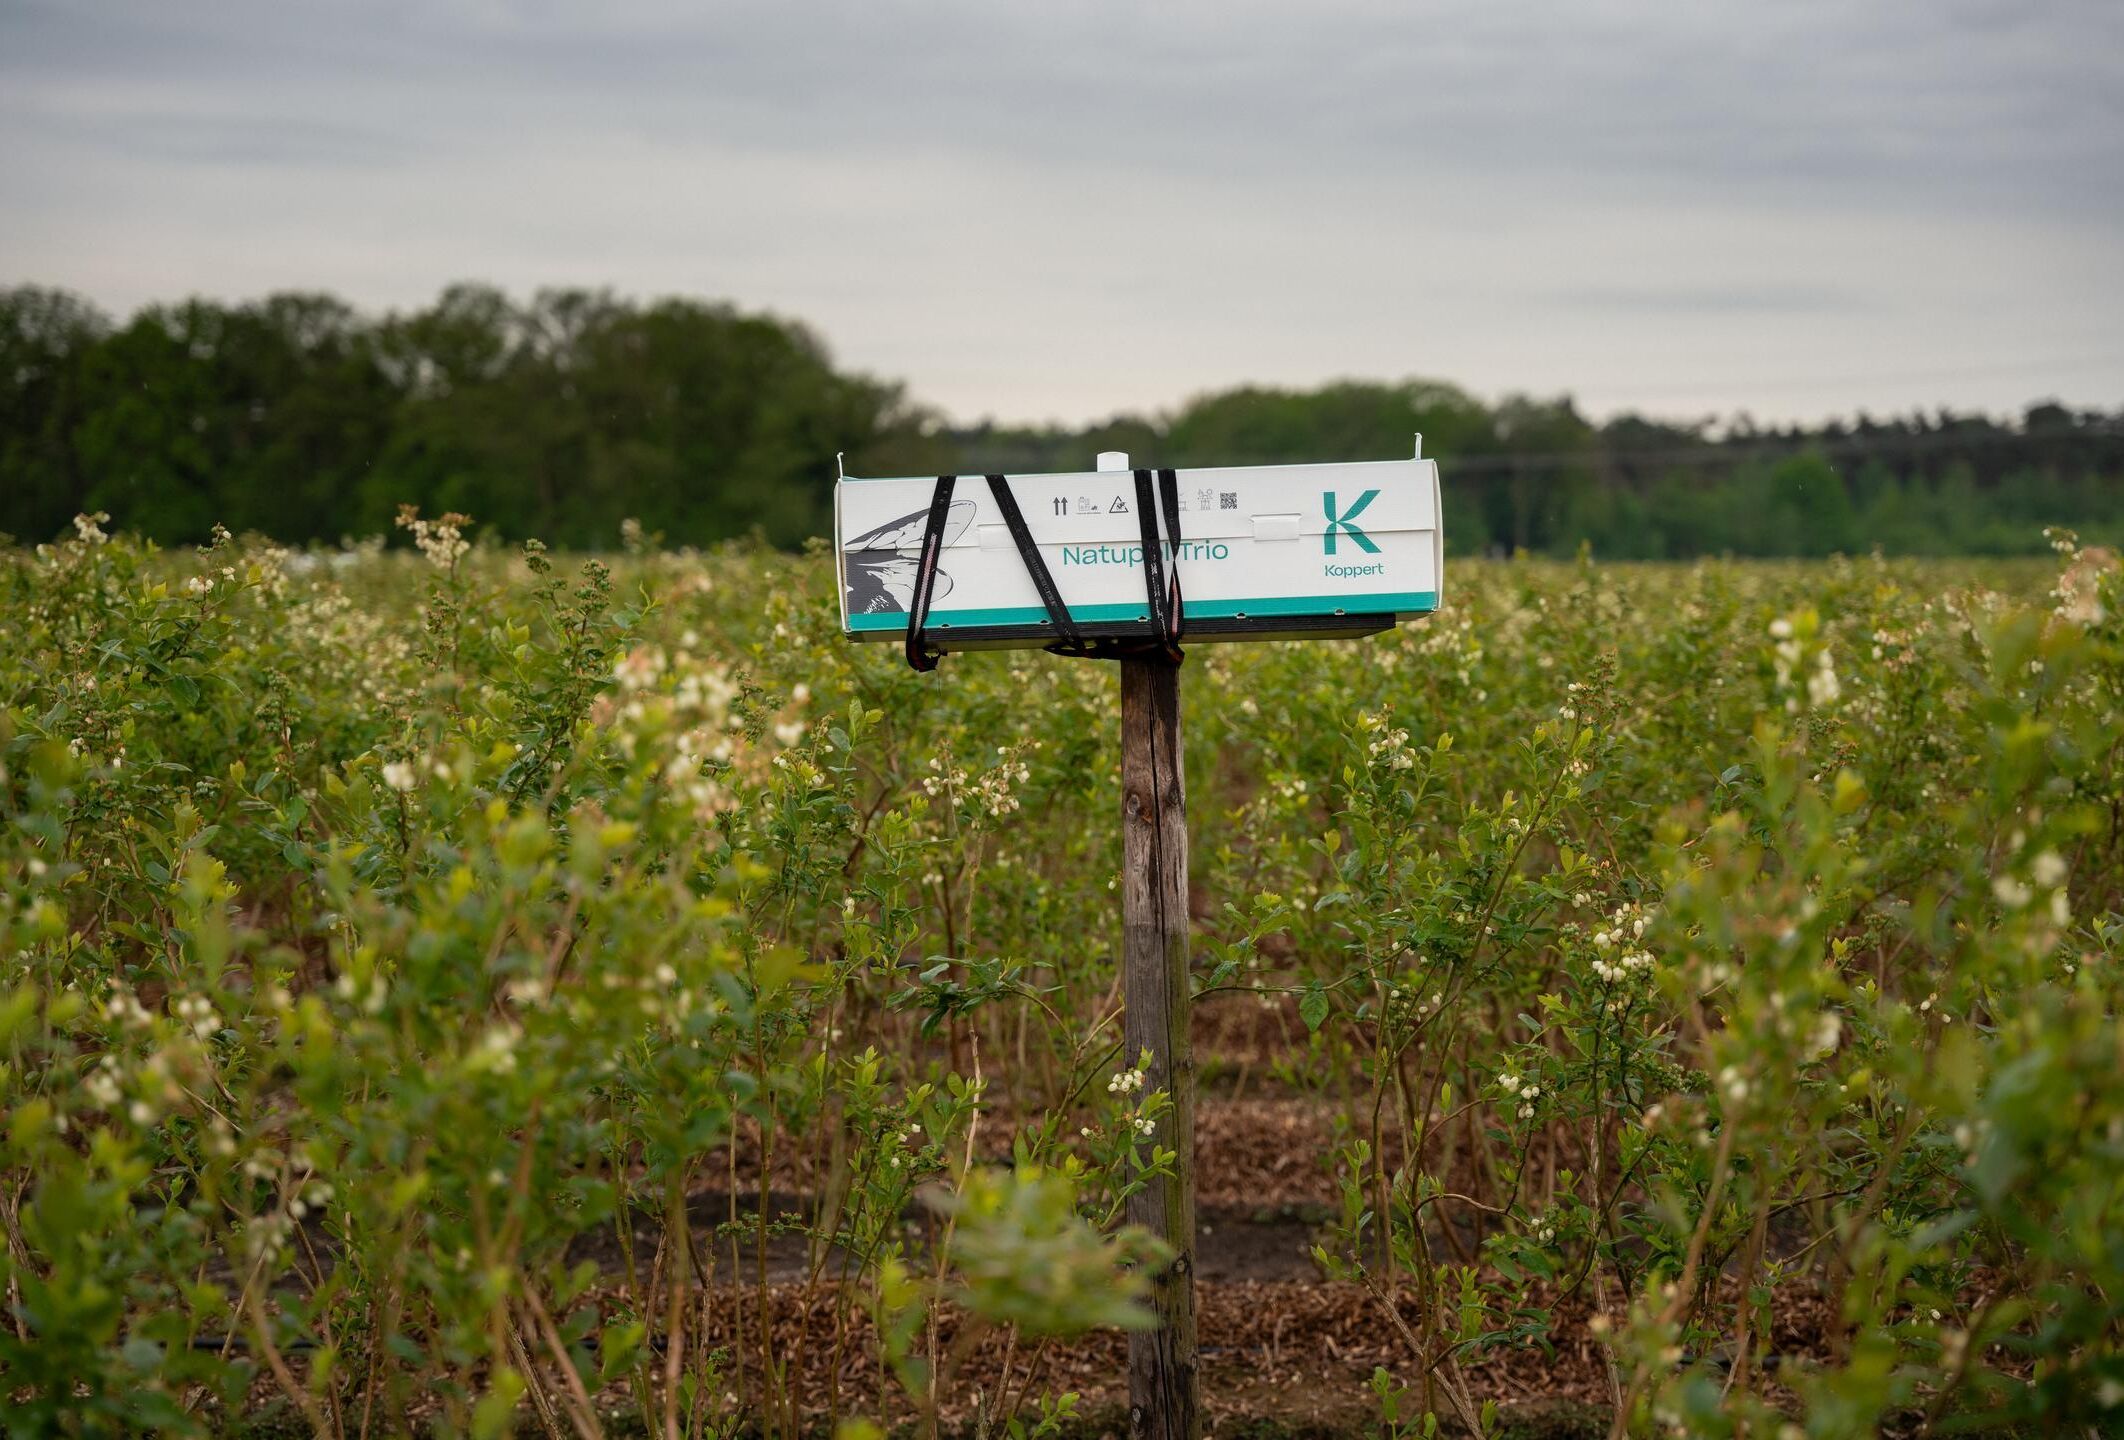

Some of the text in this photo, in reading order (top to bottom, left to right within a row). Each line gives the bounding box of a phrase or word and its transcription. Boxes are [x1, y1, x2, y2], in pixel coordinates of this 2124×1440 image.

[1323, 489, 1382, 555] K
[1063, 540, 1229, 567] Natupl Trio
[1324, 563, 1384, 578] Koppert
